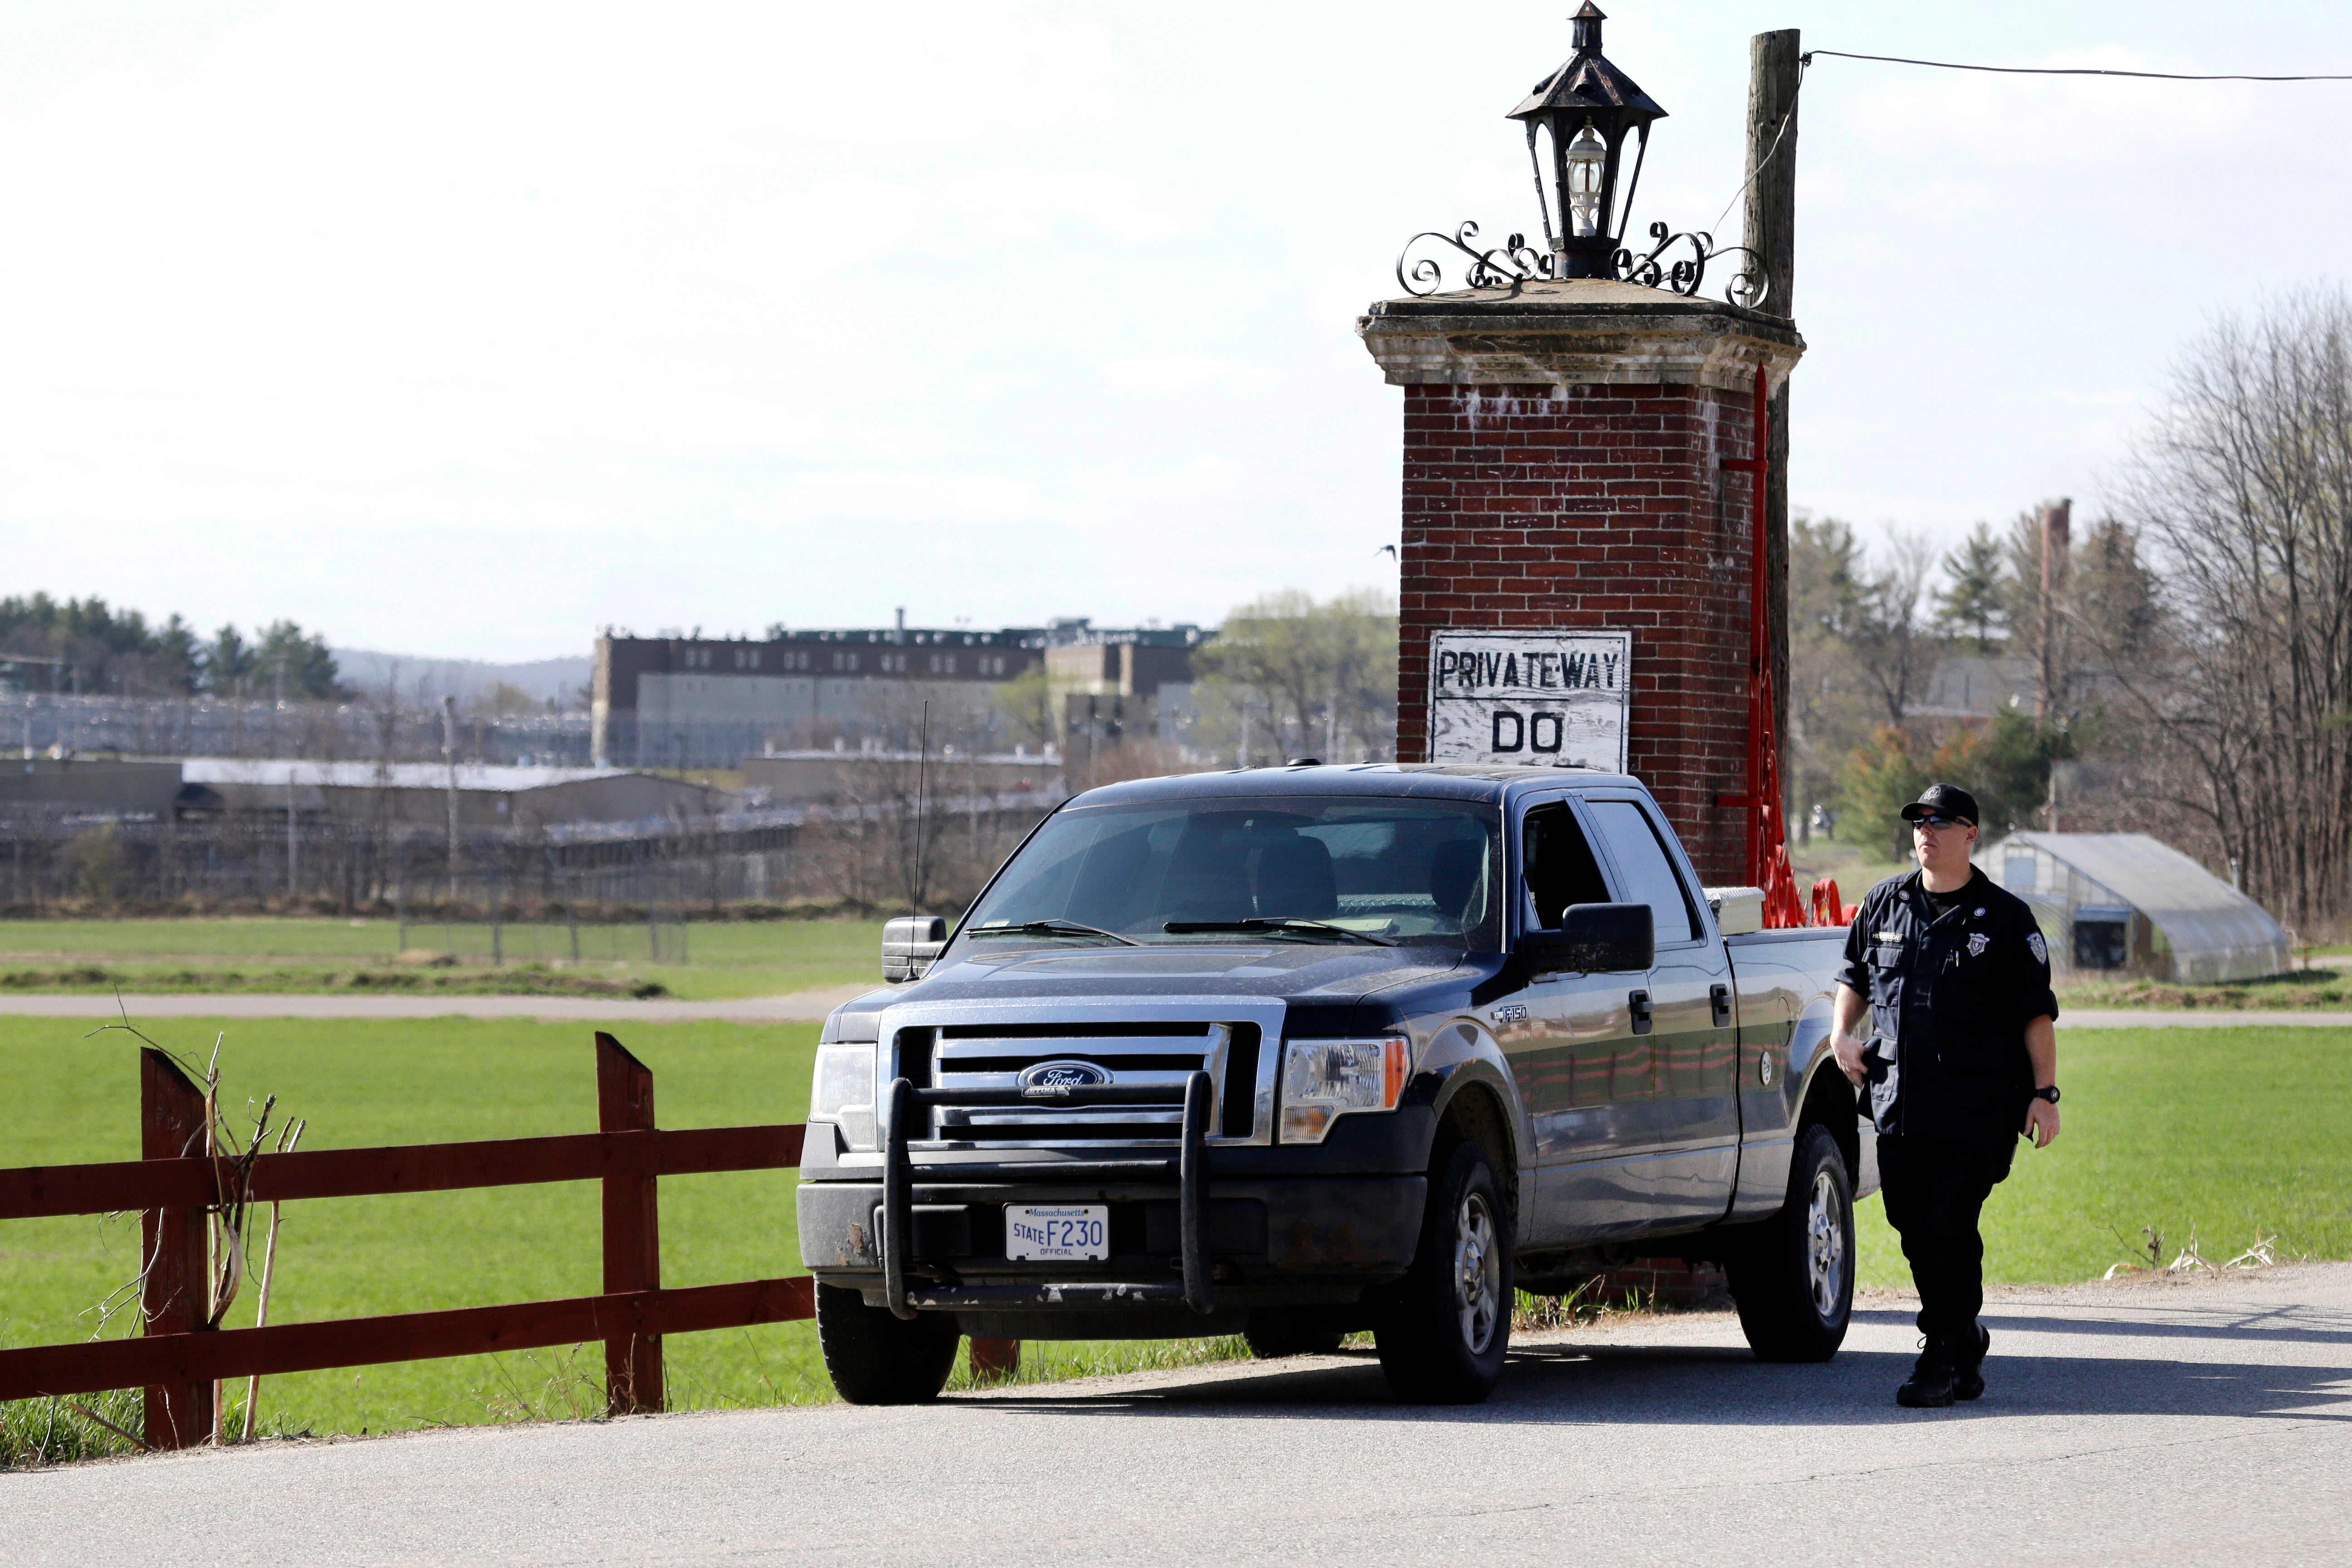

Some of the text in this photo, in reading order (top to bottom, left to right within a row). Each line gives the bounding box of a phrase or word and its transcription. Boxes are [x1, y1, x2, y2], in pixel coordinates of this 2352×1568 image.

[1492, 710, 1563, 754] DO
[1043, 1069, 1084, 1086] Ford
[1029, 1208, 1085, 1217] Massachusetts
[1014, 1220, 1102, 1247] STATE F230
